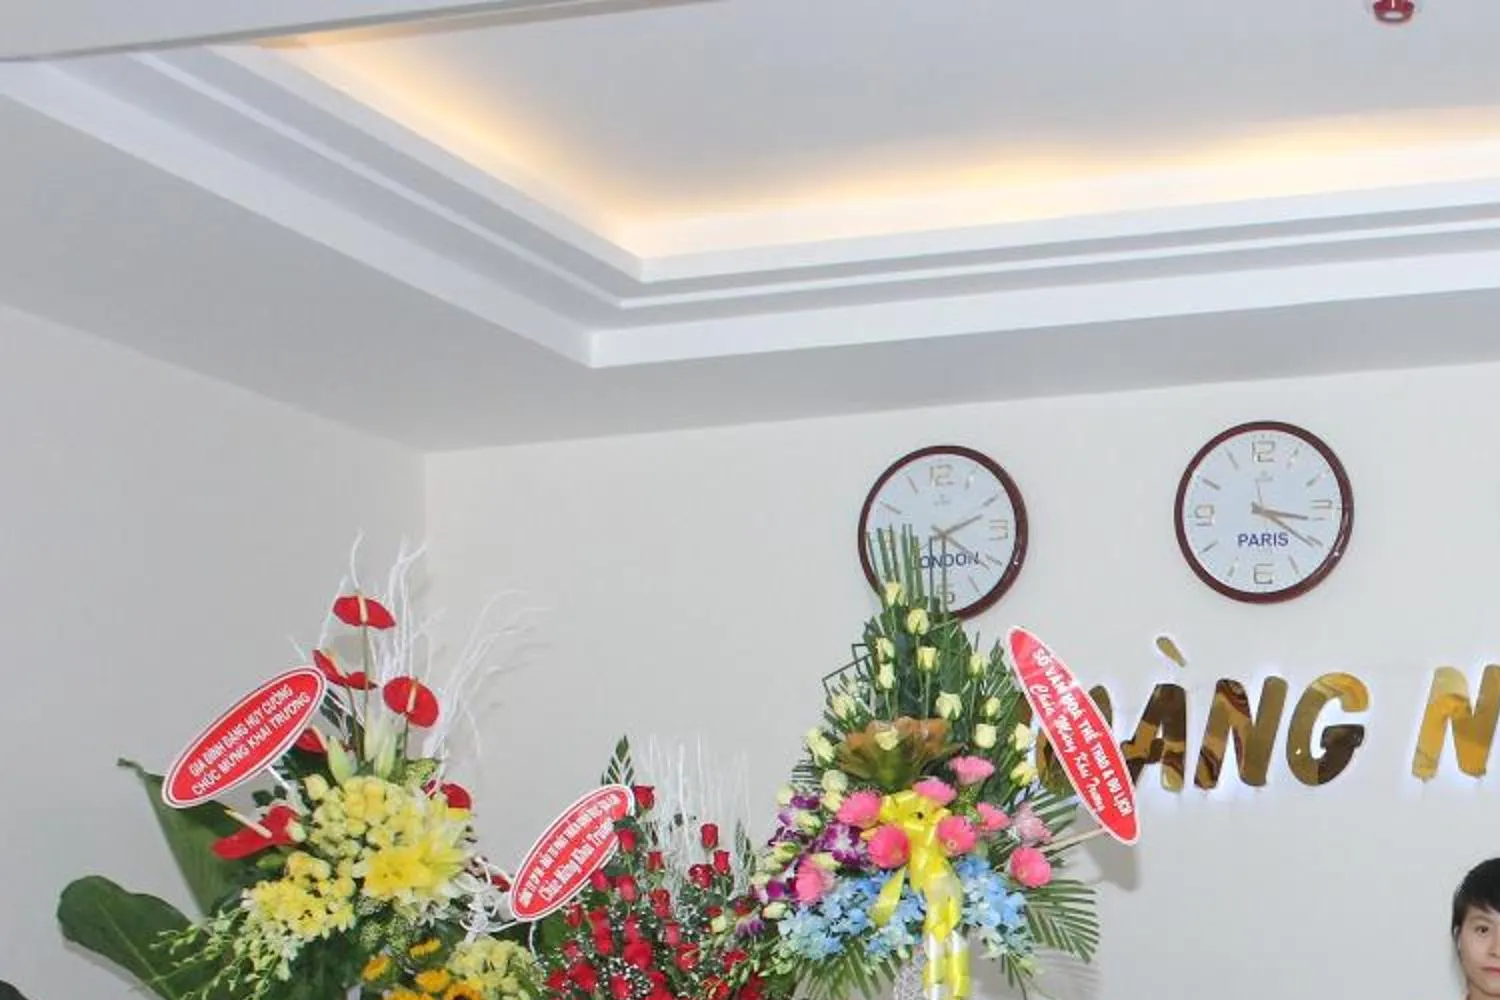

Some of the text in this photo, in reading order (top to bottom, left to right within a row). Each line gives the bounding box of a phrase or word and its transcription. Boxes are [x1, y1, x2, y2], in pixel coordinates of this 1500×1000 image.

[1252, 440, 1276, 463] 12
[929, 464, 955, 487] 12
[1194, 504, 1215, 526] 9
[1237, 533, 1289, 547] PARIS
[919, 552, 979, 569] ONDON
[1030, 636, 1370, 792] ÀNG
[189, 759, 207, 776] GIA
